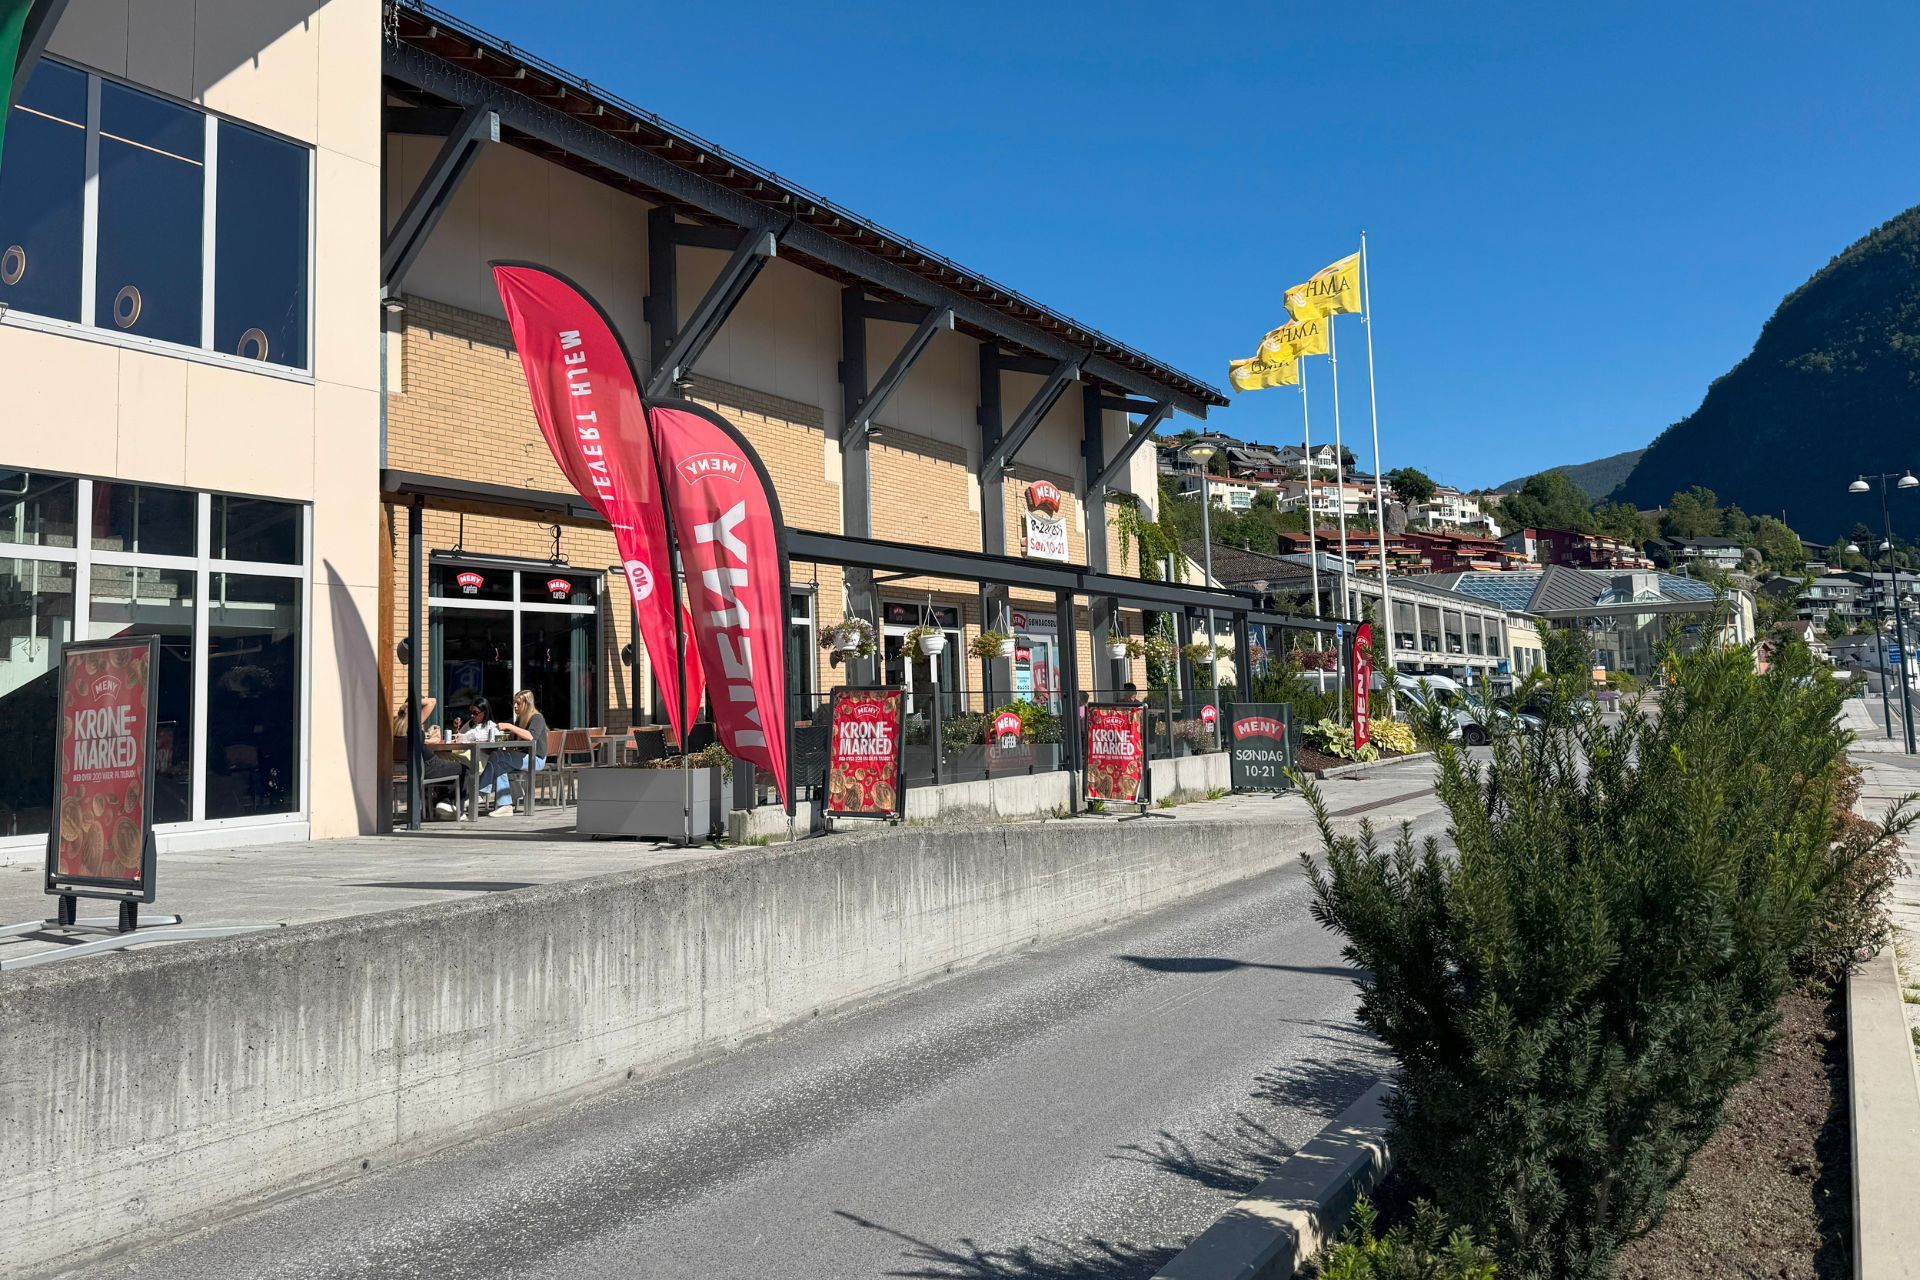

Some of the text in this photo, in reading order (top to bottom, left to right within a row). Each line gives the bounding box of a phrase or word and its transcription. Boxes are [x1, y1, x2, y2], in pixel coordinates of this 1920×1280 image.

[1036, 485, 1061, 503] MENY
[95, 680, 118, 694] MENY
[1356, 650, 1367, 739] MENY
[75, 705, 137, 740] KRONE-
[840, 721, 892, 739] KRONE-
[997, 717, 1019, 731] MENY
[1238, 721, 1280, 735] MENY
[1092, 729, 1134, 743] KRONE-
[74, 736, 137, 771] MARKED
[839, 738, 893, 755] MARKED
[1092, 741, 1135, 756] MARKED
[1236, 749, 1284, 762] SØNDAG
[1245, 765, 1275, 777] 10-21
